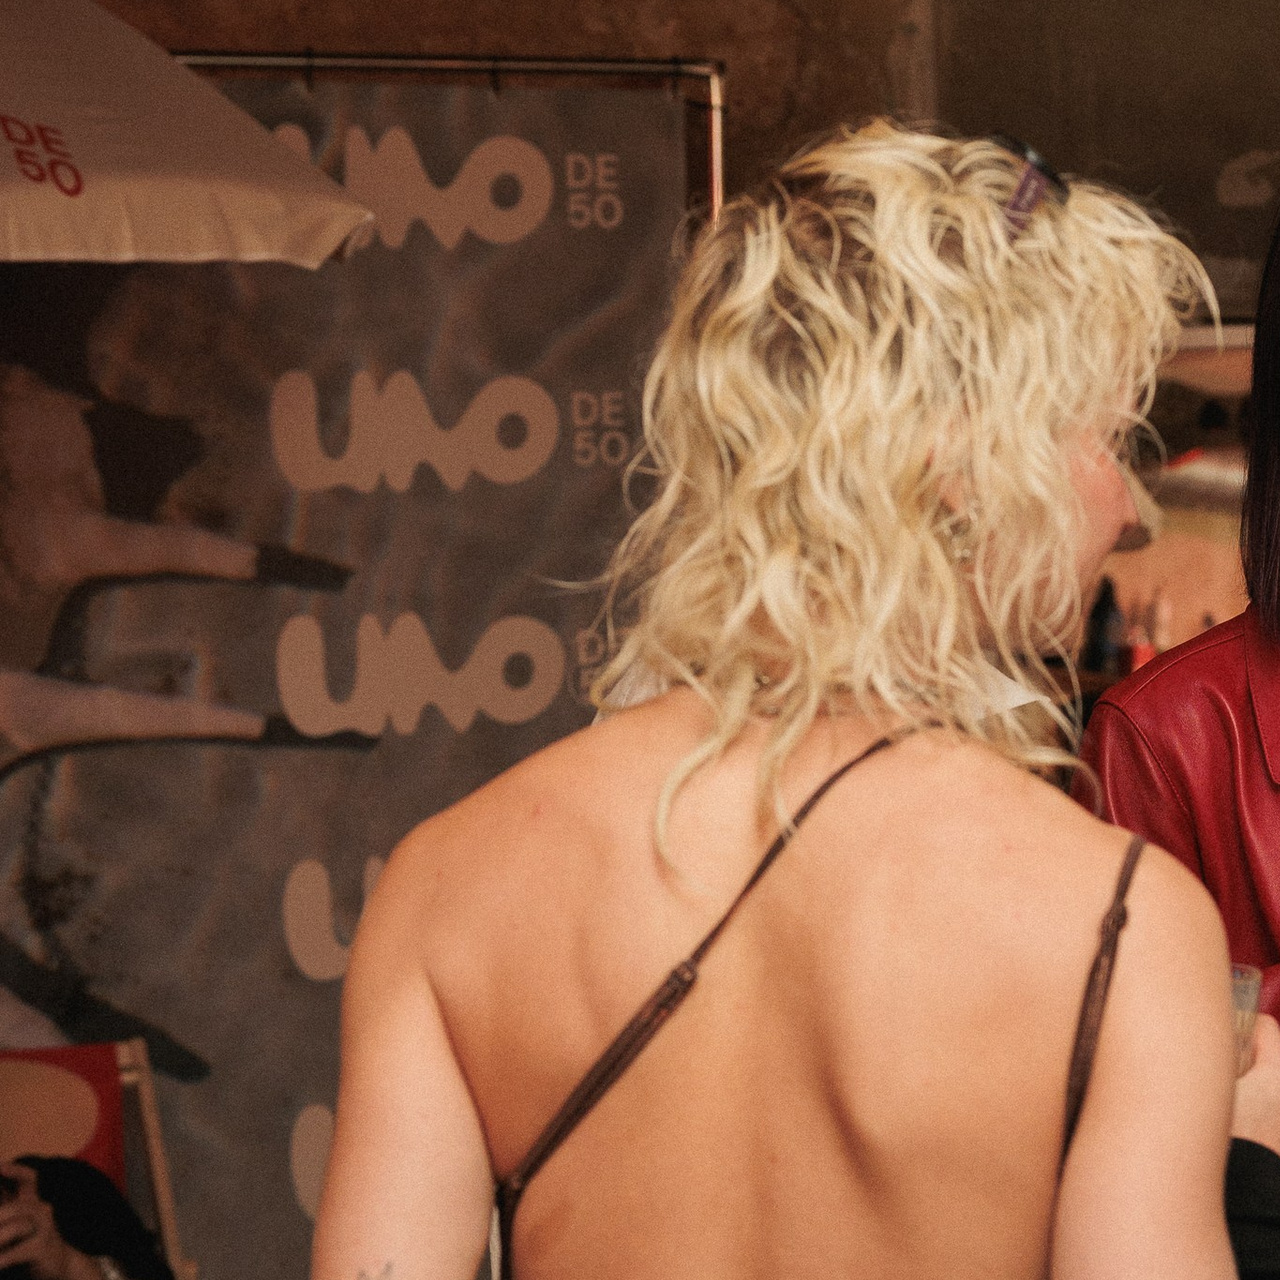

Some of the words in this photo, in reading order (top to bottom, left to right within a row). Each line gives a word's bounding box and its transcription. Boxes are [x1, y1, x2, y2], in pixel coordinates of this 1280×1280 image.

[0, 114, 71, 158] DE
[14, 148, 83, 197] 50
[565, 153, 619, 189] DE
[567, 192, 623, 229] 50
[571, 391, 623, 427] DE
[573, 430, 629, 467] 50
